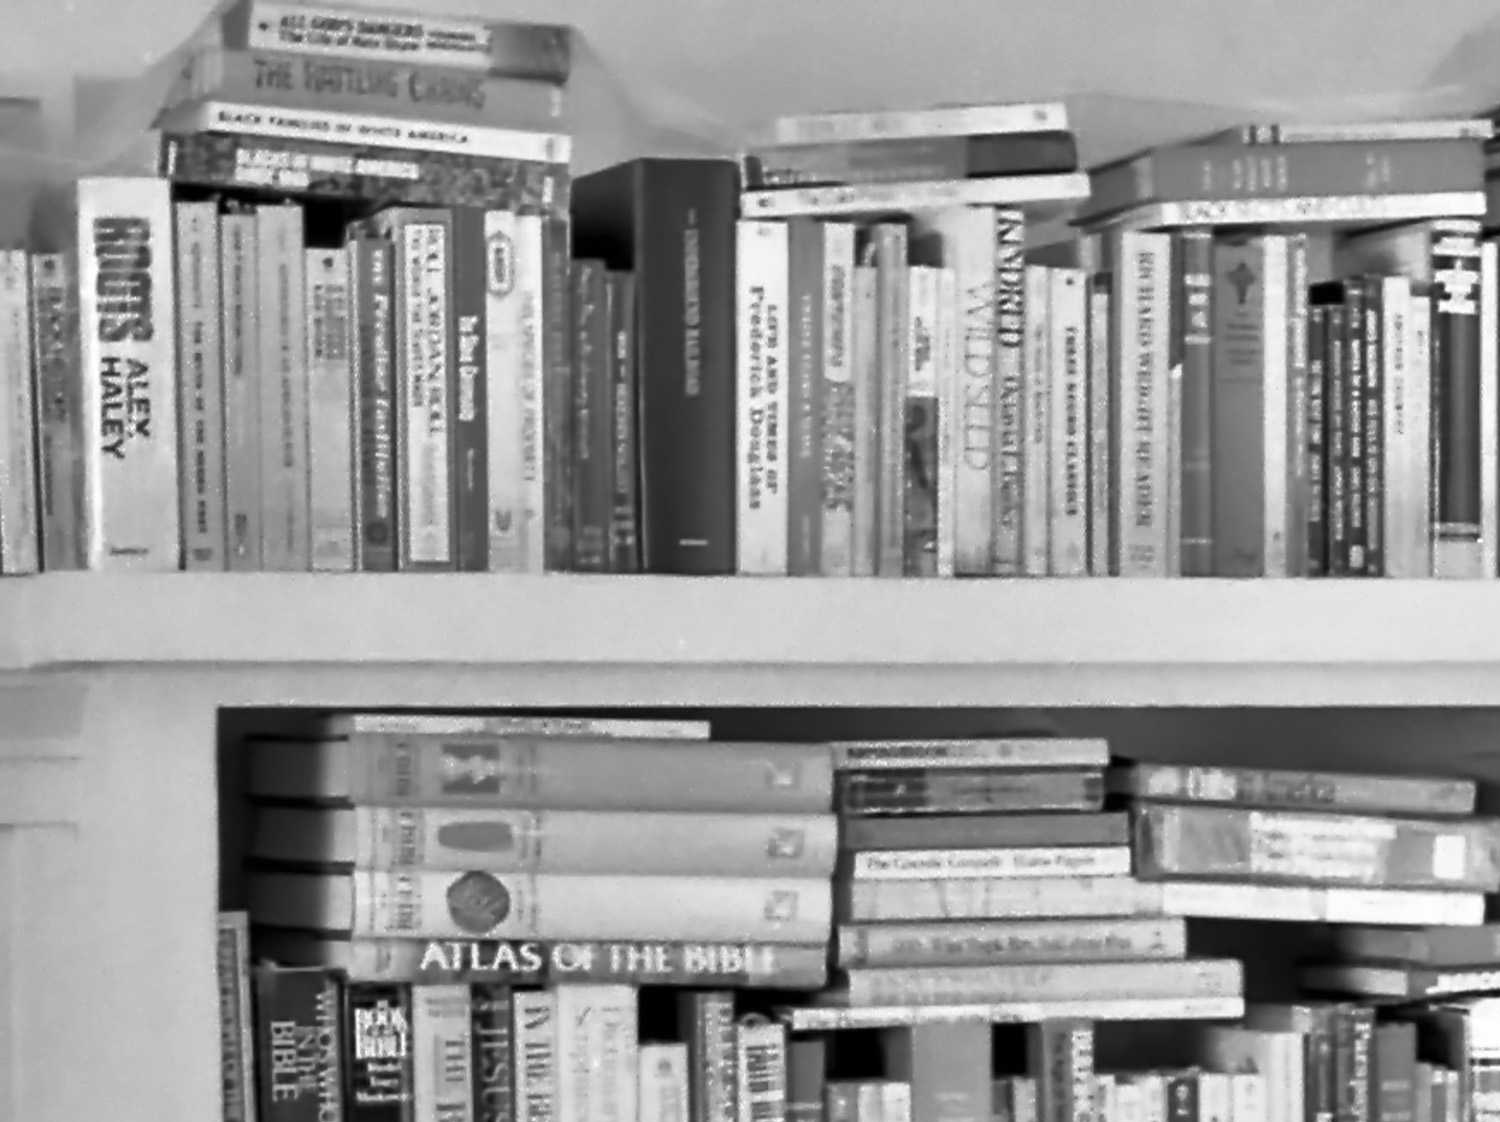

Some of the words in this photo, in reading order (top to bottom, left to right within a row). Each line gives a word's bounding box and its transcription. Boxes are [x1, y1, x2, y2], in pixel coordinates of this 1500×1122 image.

[254, 58, 295, 91] THE
[218, 110, 262, 123] BLACK
[407, 129, 469, 144] AMERICA
[94, 216, 154, 344] ROOTS
[748, 285, 767, 399] Frederick
[99, 355, 125, 460] HALEY
[126, 357, 151, 439] ALEX
[748, 407, 767, 511] Douglass
[419, 942, 543, 974] ATLAS
[551, 944, 596, 973] OF
[609, 945, 675, 974] THE
[684, 946, 777, 975] BIBLE
[524, 1006, 553, 1030] IN
[270, 1020, 298, 1103] BIBLE
[298, 1055, 317, 1092] THE
[445, 1039, 466, 1084] THE
[525, 1042, 553, 1080] THE
